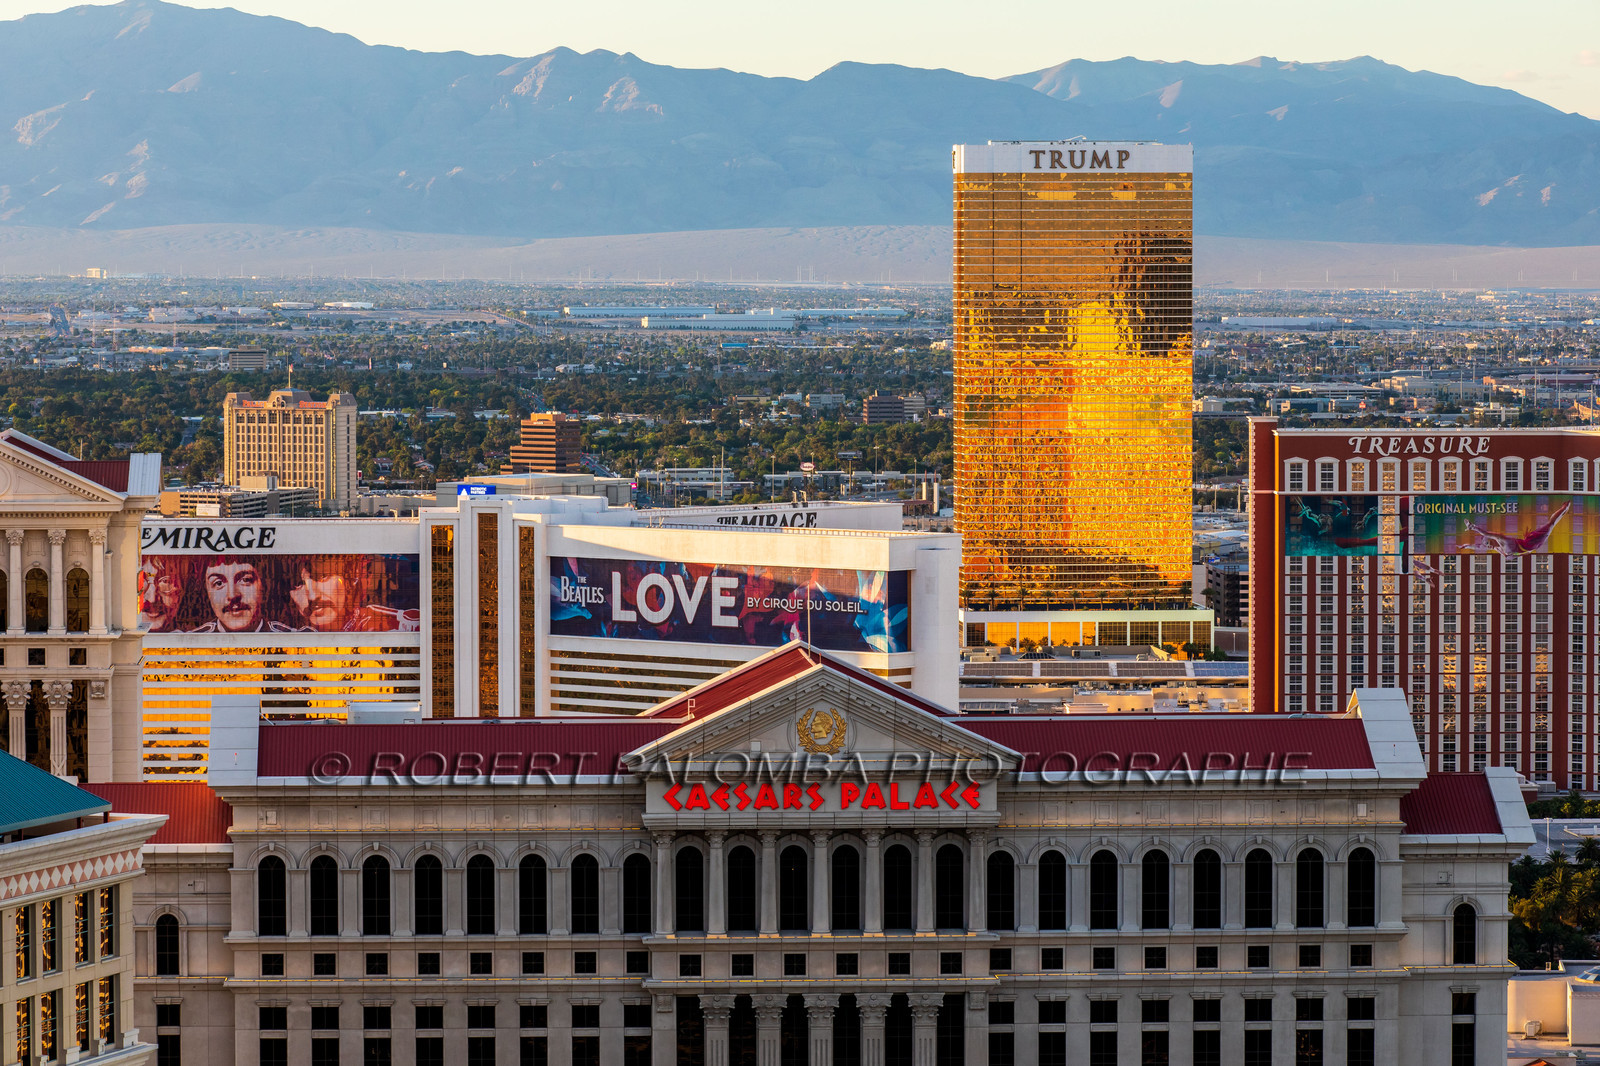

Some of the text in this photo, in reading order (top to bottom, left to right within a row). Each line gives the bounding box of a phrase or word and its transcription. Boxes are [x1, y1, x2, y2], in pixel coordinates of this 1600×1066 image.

[1029, 149, 1130, 169] TRUMP
[1348, 436, 1491, 457] TREASURE
[1416, 503, 1518, 514] ORIGINAL MUST-SEE
[142, 527, 276, 552] MIRAGE
[577, 576, 587, 584] THE
[560, 576, 605, 607] BEATLES
[611, 571, 739, 628] LOVE
[747, 597, 761, 608] BY
[763, 597, 804, 613] CIRQUE
[806, 600, 823, 611] DU
[662, 780, 982, 812] CAESARS PALACE
